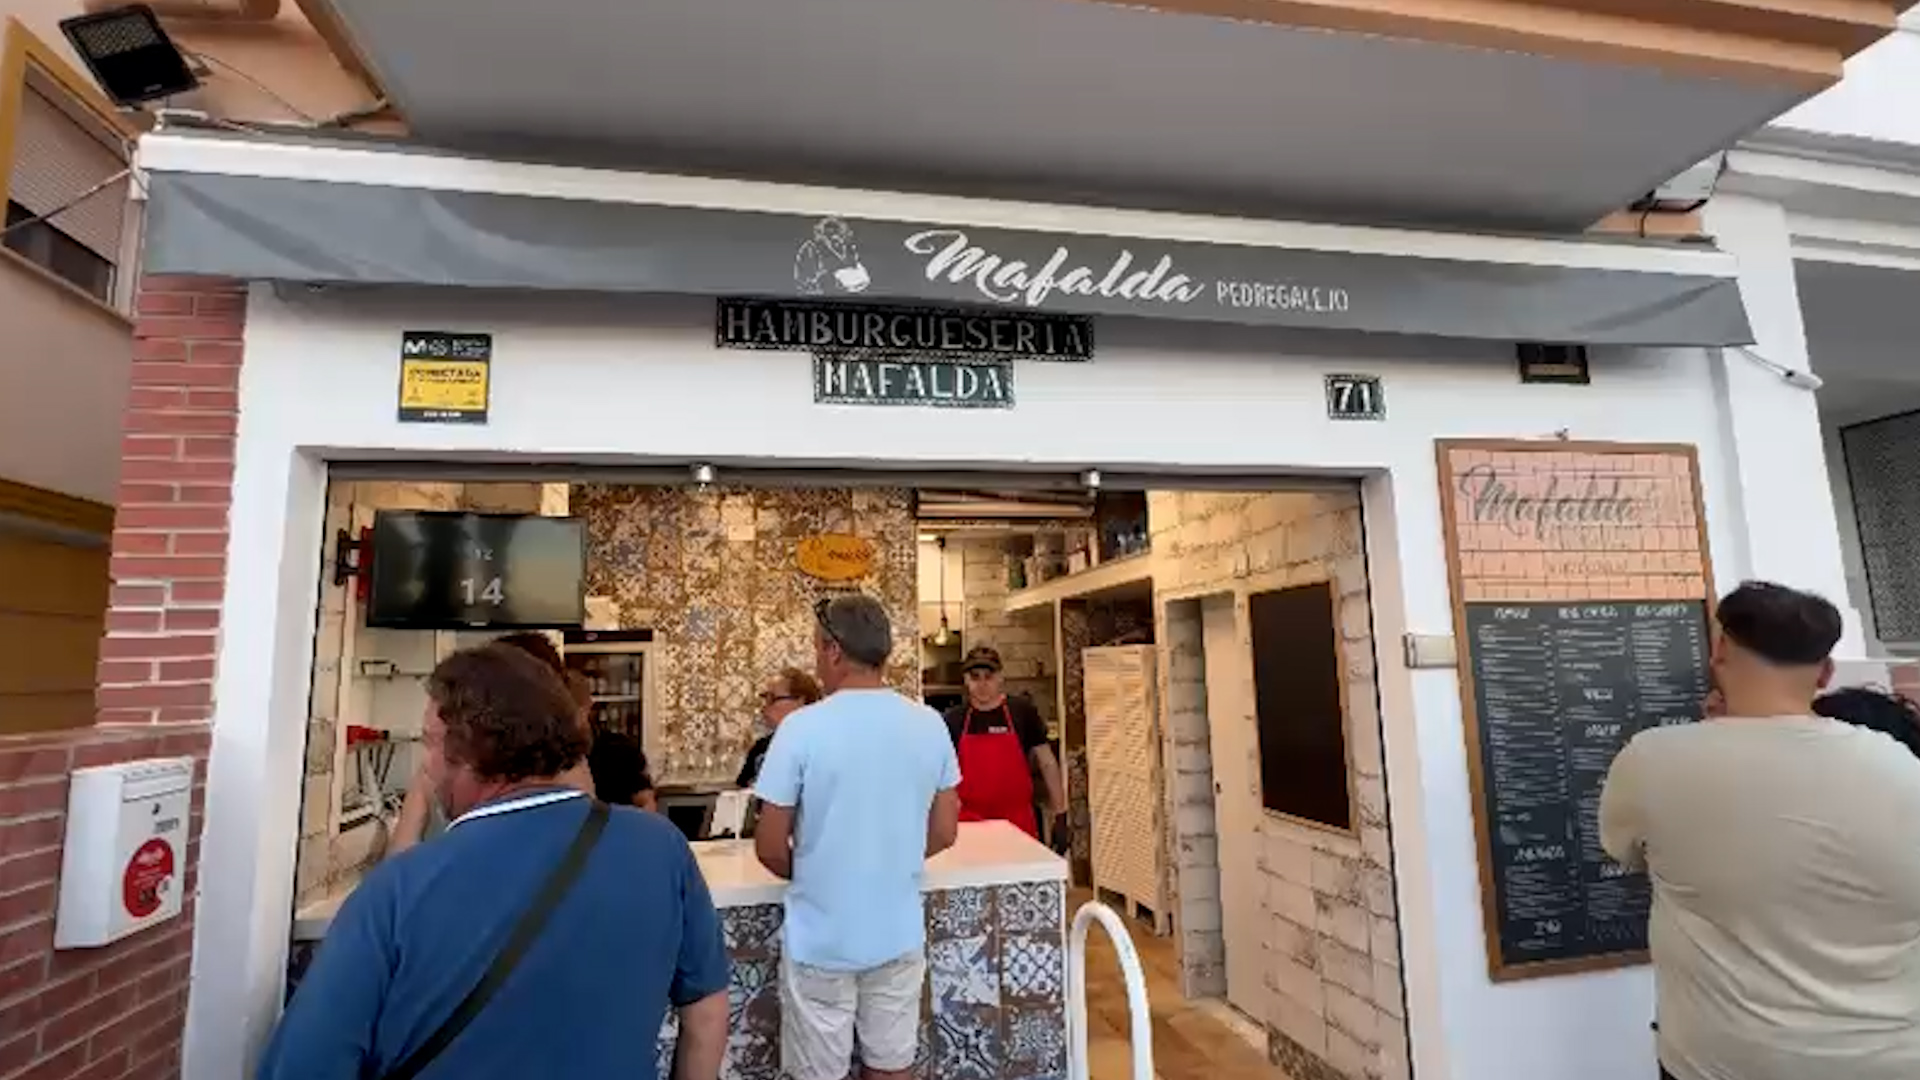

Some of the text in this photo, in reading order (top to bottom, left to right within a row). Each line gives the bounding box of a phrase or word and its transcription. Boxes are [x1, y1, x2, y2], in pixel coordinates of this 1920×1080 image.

[904, 230, 1349, 312] Mafalda PEDREGALEJO
[726, 306, 1084, 355] HAMBURGUESERIA
[823, 360, 1003, 399] MAFALDA
[1333, 381, 1372, 413] 71
[460, 577, 504, 606] 14
